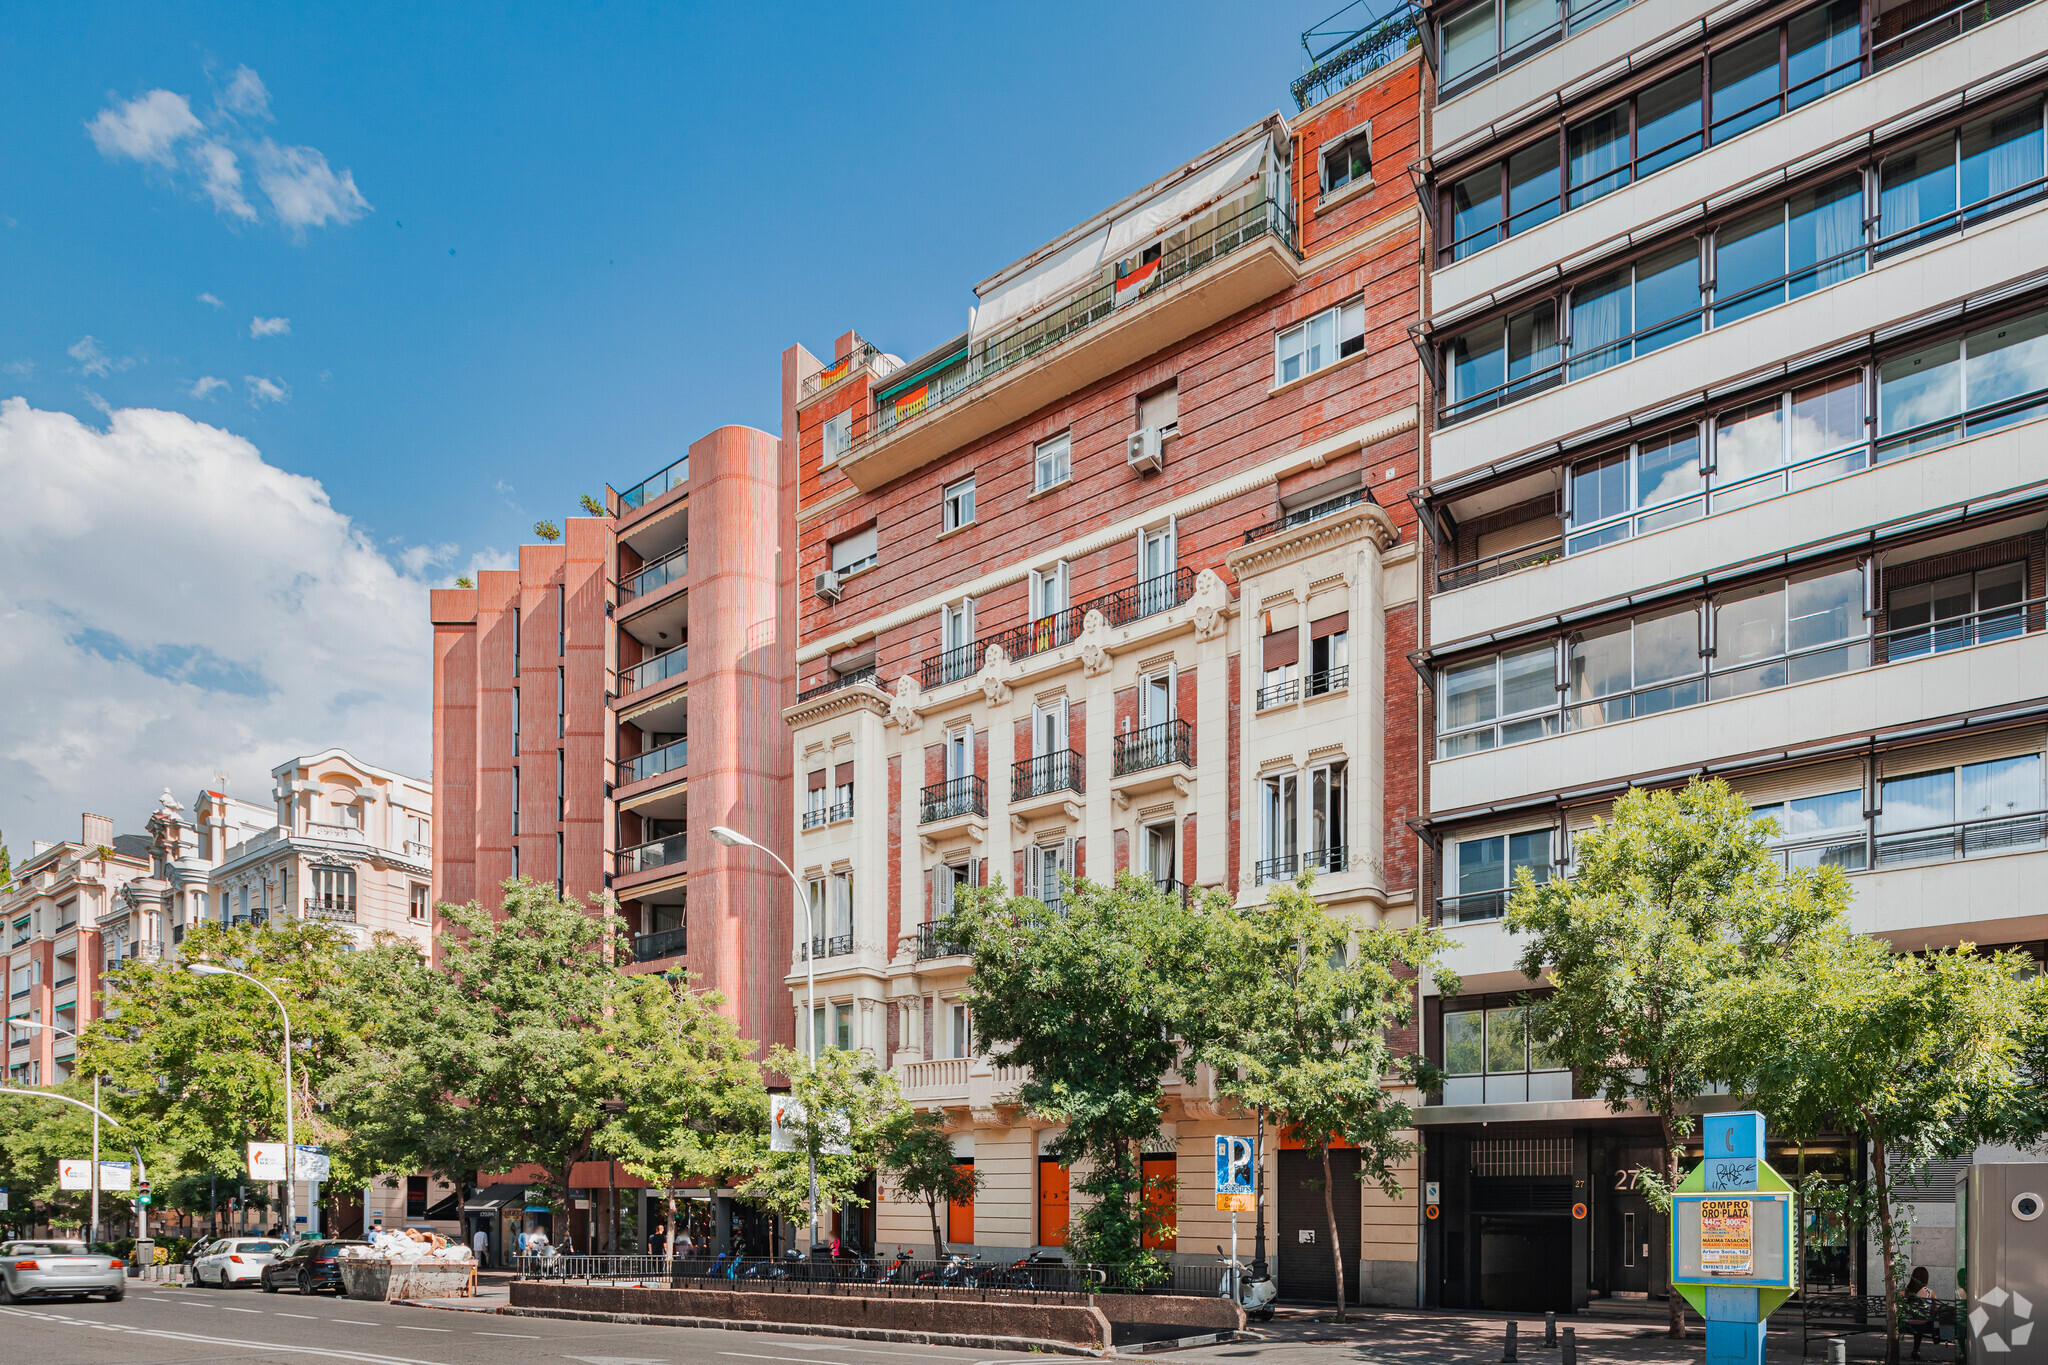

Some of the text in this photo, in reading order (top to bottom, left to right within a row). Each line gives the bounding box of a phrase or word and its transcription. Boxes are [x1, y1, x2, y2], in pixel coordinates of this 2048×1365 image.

[1614, 1169, 1641, 1190] 27
[1575, 1180, 1585, 1188] 27
[1702, 1201, 1749, 1209] COMPRO
